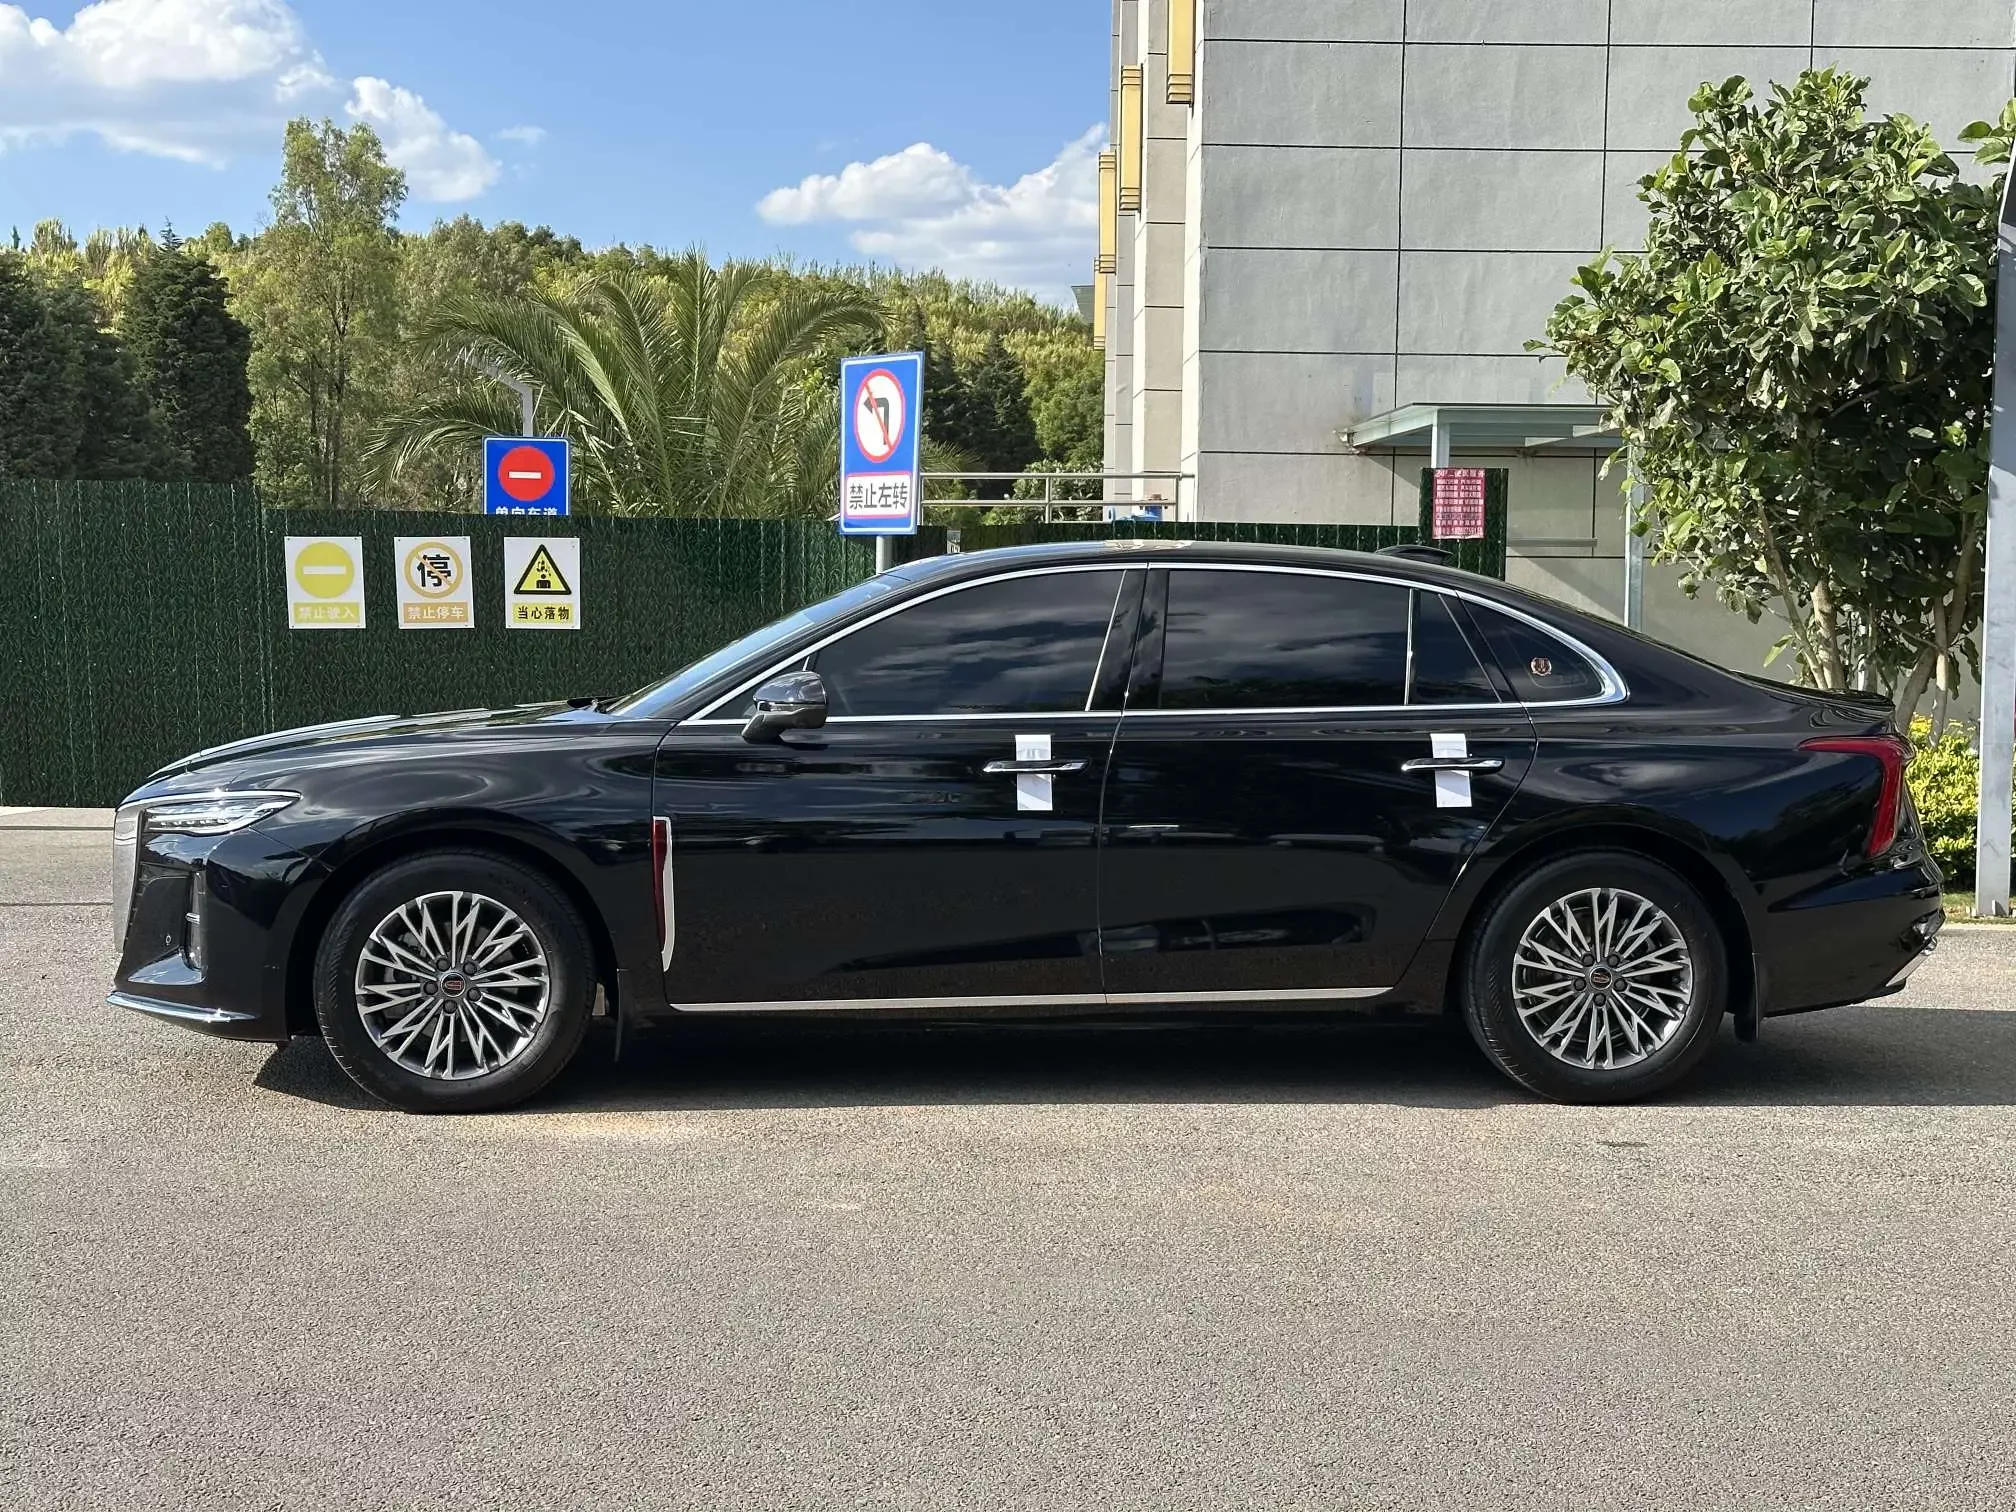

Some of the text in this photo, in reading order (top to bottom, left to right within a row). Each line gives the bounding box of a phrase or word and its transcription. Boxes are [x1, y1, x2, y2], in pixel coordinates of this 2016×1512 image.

[849, 482, 908, 509] 禁止左转
[416, 553, 452, 588] 停
[408, 606, 464, 620] 禁止停车
[517, 606, 570, 620] 当心落物
